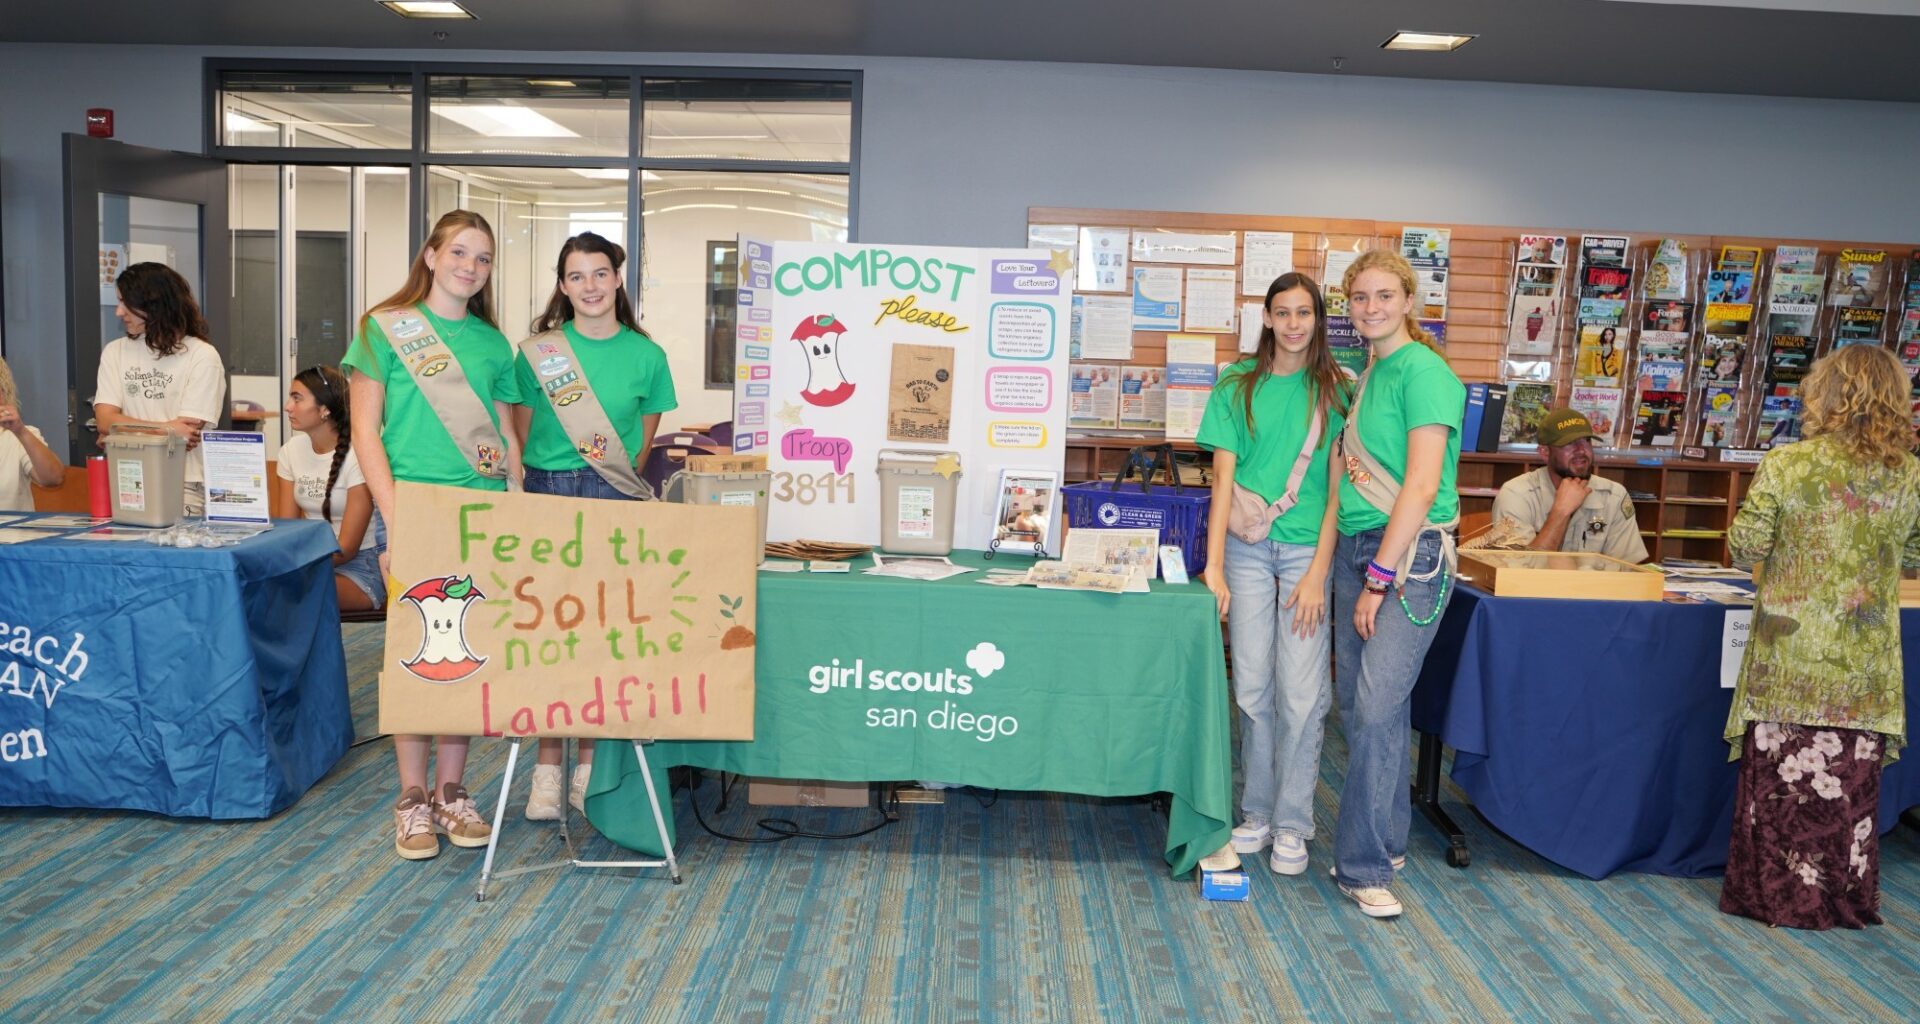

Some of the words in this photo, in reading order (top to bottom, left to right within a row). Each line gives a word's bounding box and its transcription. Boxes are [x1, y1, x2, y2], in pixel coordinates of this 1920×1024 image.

[1520, 236, 1554, 246] AAP
[1584, 238, 1598, 247] CAR
[1602, 239, 1624, 248] DRIVER
[1840, 249, 1888, 263] Sunset
[774, 249, 976, 302] COMPOST
[1018, 279, 1055, 287] Leftovers!
[1711, 272, 1740, 281] OUT
[874, 295, 969, 333] please
[1581, 305, 1593, 314] CR
[1771, 304, 1788, 312] SAN
[1788, 305, 1815, 313] DIEGO
[1327, 328, 1350, 336] BUCKLE
[402, 336, 436, 354] 3844
[124, 371, 153, 381] Solana
[152, 367, 174, 384] Beach
[1642, 363, 1683, 378] Kiplinger
[142, 379, 168, 389] CLEAN
[547, 372, 576, 391] 3844
[906, 380, 916, 389] BAG
[923, 380, 939, 391] EARTH
[1574, 391, 1598, 400] Crochet
[1598, 393, 1618, 401] World
[786, 431, 850, 472] Troop
[774, 471, 855, 505] 3844
[459, 502, 584, 568] Feed
[608, 527, 688, 566] the
[0, 621, 89, 681] each
[505, 631, 580, 670] not
[606, 625, 684, 661] the
[0, 661, 65, 709] AN
[808, 658, 863, 694] girl
[868, 668, 973, 695] scouts
[481, 673, 707, 737] Landfill
[865, 707, 917, 728] san
[927, 700, 1018, 742] diego
[0, 727, 47, 762] en
